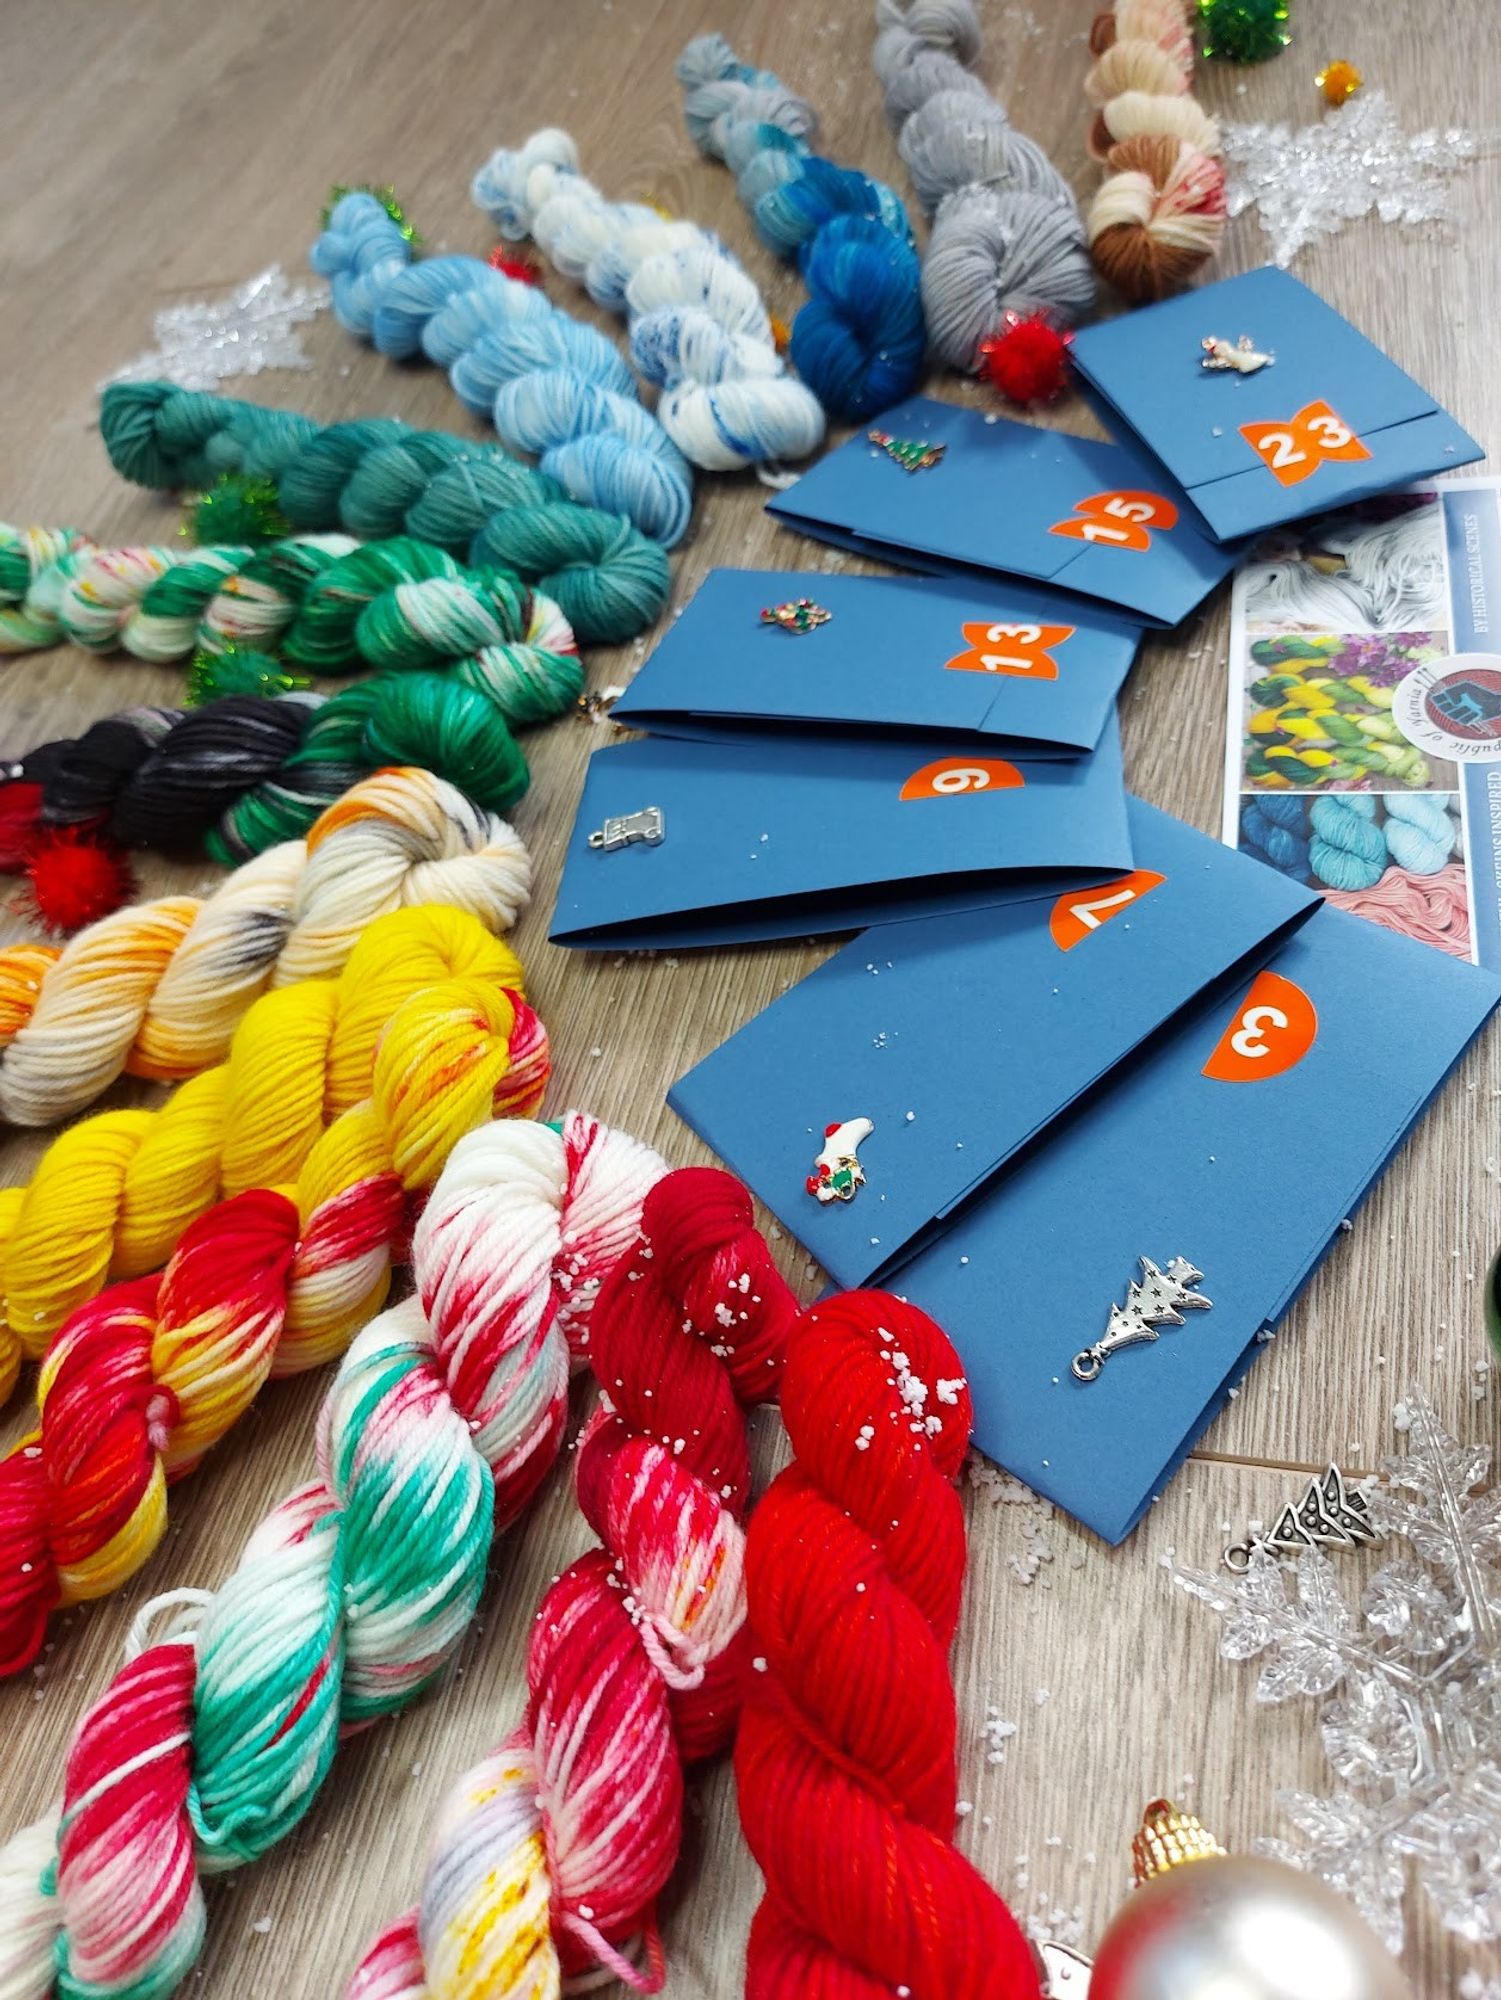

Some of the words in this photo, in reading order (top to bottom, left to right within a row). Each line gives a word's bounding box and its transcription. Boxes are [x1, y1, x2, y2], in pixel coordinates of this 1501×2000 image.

[1257, 415, 1351, 469] 23
[1081, 497, 1156, 541] 15
[1463, 513, 1481, 553] SCENES
[1467, 554, 1487, 617] HISTORICAL
[1473, 617, 1488, 633] BY
[980, 623, 1042, 671] 13
[1406, 688, 1429, 727] Yarnia
[1420, 731, 1443, 742] of
[932, 768, 990, 793] 9
[1487, 771, 1501, 835] INSPIRED
[1069, 889, 1137, 930] 7
[1231, 1006, 1288, 1058] 3
